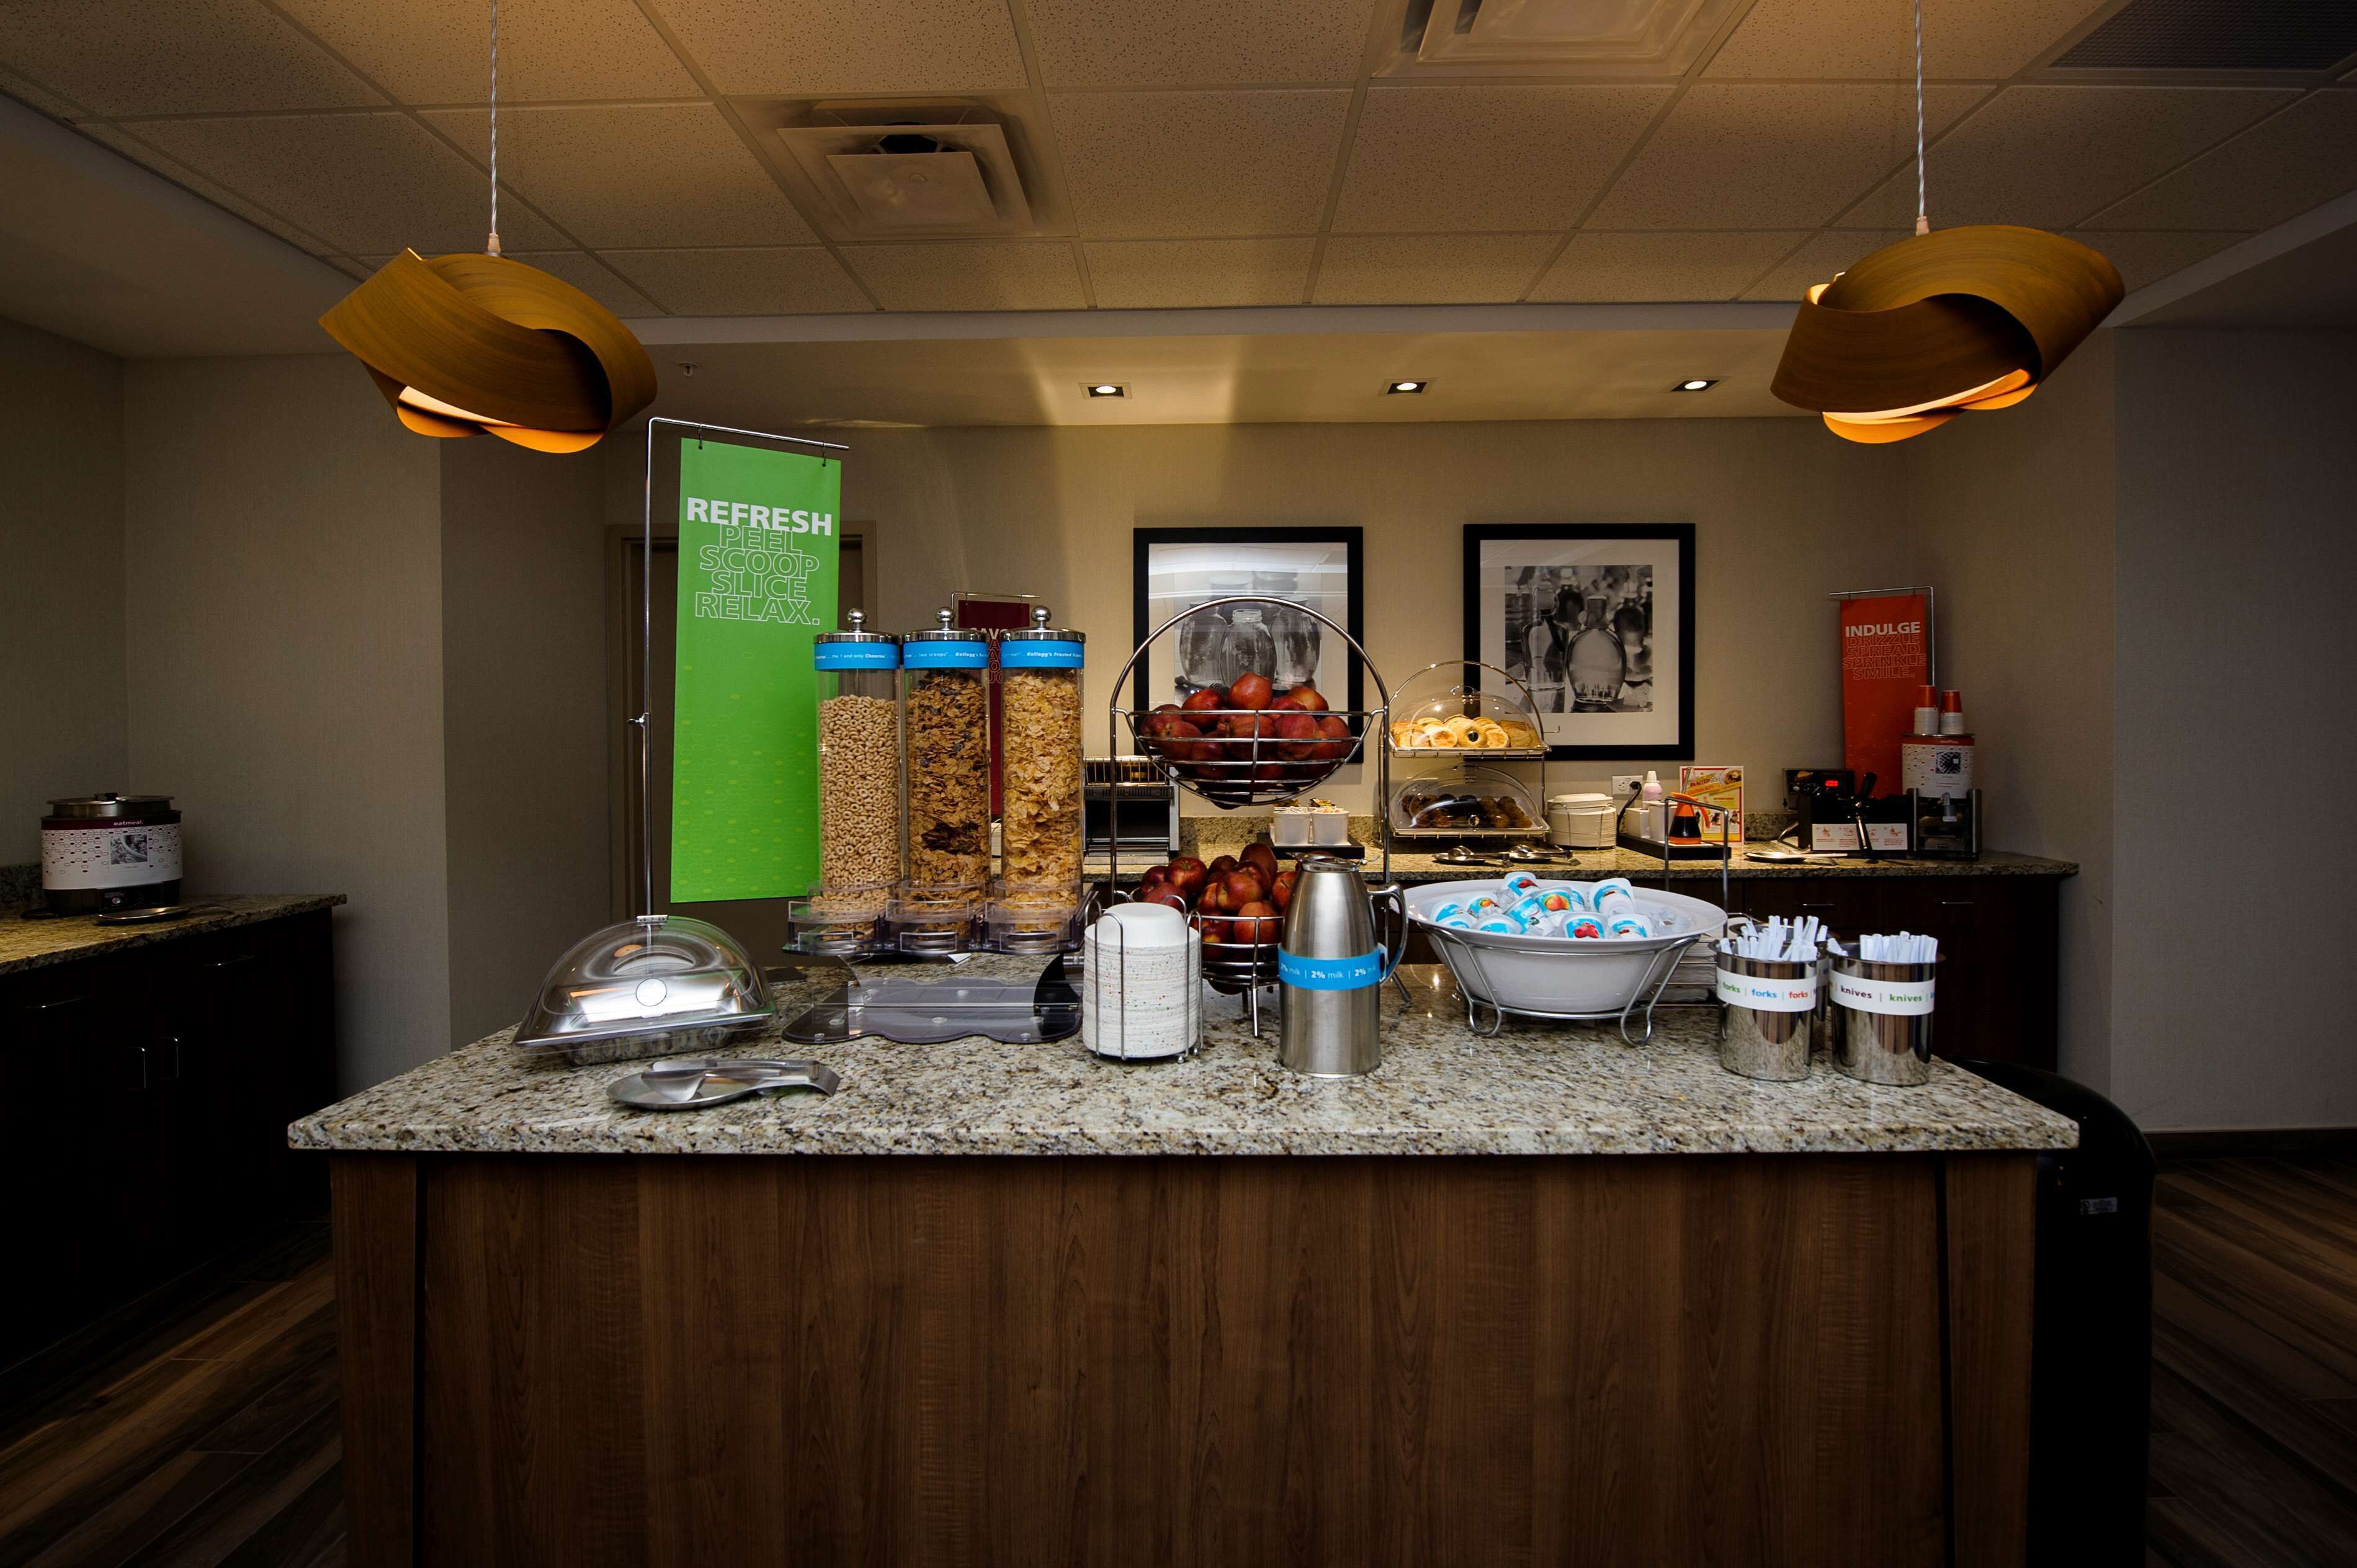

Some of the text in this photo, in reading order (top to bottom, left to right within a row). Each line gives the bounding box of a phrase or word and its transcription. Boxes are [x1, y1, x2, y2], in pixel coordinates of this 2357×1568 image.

[687, 497, 832, 536] REFRESH
[720, 524, 802, 555] PEEL
[700, 545, 820, 577] SCOOP
[712, 571, 807, 602] SLICE
[695, 592, 820, 625] RELAX.
[1846, 622, 1920, 637] INDULGE
[1847, 633, 1921, 647] DRIZZLE
[1847, 644, 1921, 658] SPREAD
[1842, 654, 1926, 670] SPRINKLE
[1853, 666, 1916, 680] SMILE.
[1312, 971, 1325, 979] 2%
[1328, 971, 1343, 979] milk
[1354, 968, 1366, 977] 2%
[1751, 988, 1778, 999] forks
[1789, 991, 1809, 999] forks
[1840, 985, 1872, 999] knives
[1889, 993, 1923, 1002] knives
